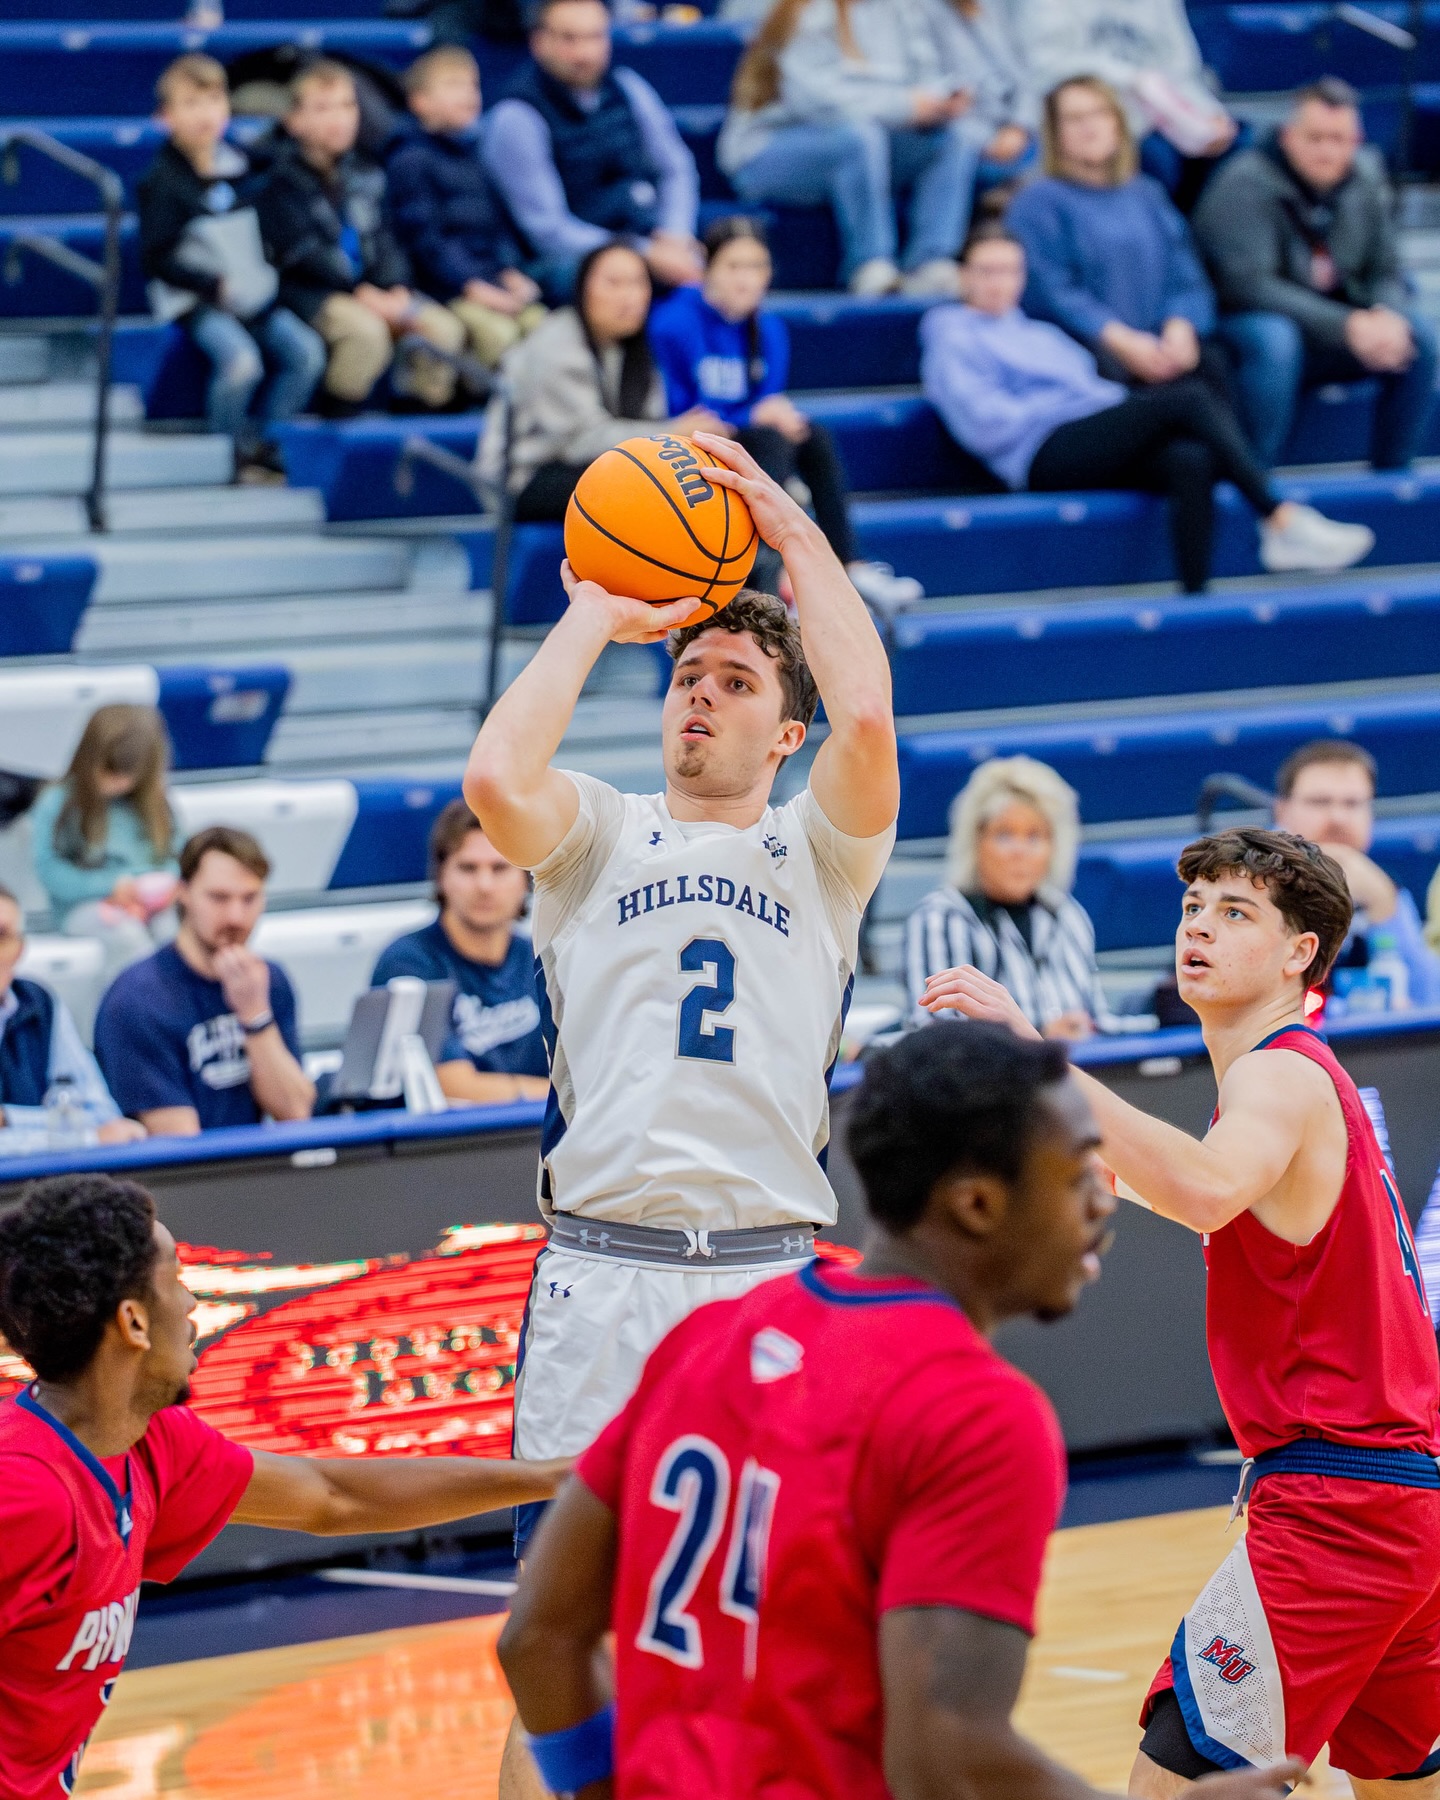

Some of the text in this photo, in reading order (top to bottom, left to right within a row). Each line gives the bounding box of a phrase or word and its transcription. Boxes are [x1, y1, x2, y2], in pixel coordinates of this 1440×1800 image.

[650, 435, 714, 509] Wilso
[618, 874, 790, 938] HILLSDALE
[674, 934, 739, 1066] 2
[1198, 1635, 1256, 1684] MU
